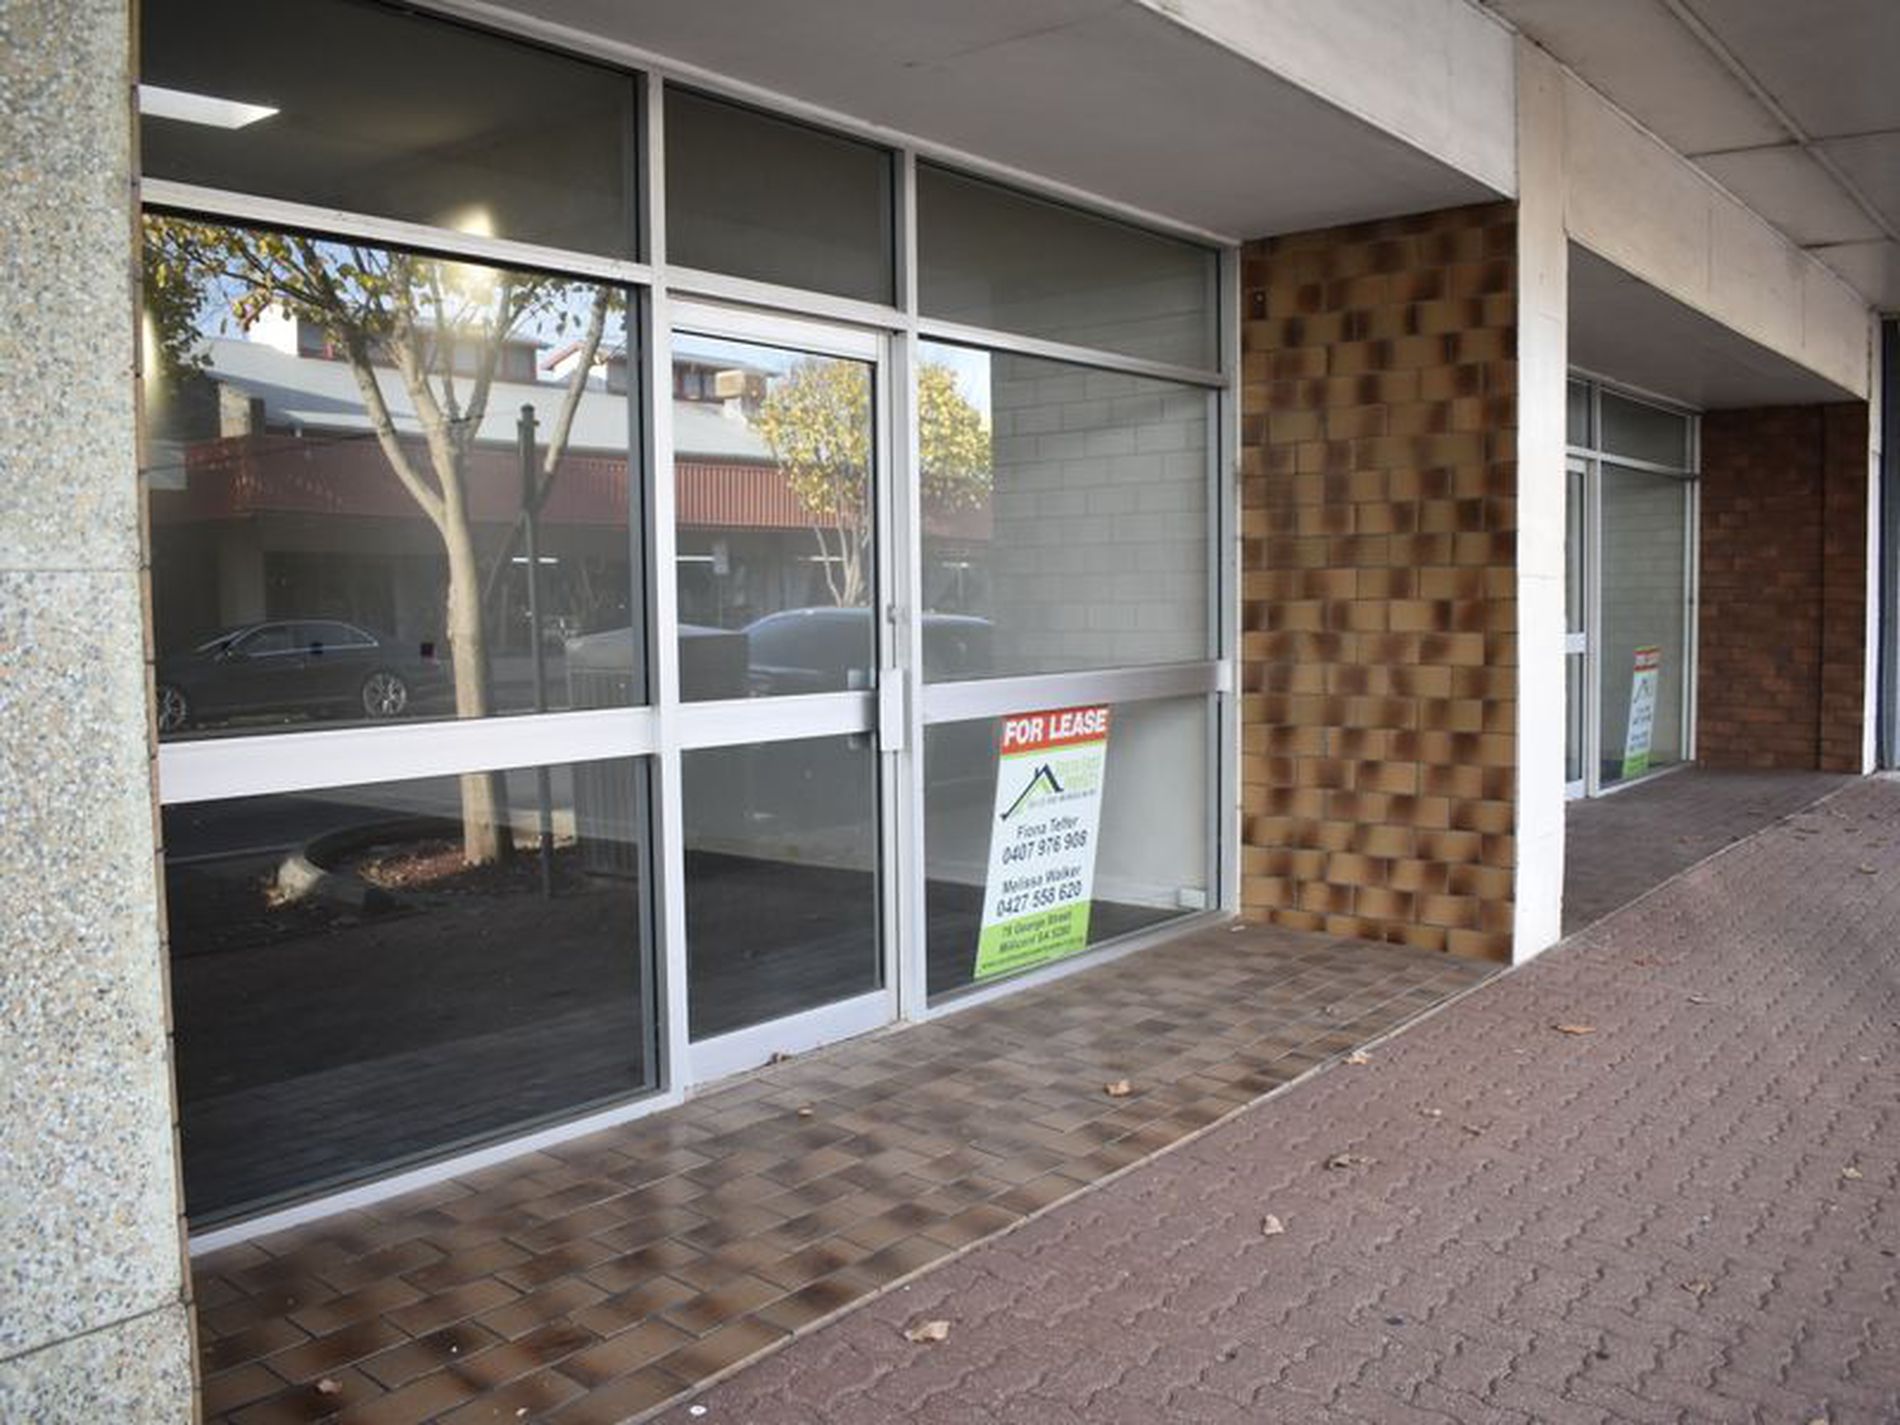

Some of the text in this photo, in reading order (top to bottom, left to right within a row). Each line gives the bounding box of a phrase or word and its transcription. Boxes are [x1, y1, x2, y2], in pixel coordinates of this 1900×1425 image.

[1003, 709, 1109, 746] FOR LEASE
[1002, 841, 1035, 865] 0407
[997, 892, 1030, 917] 0427
